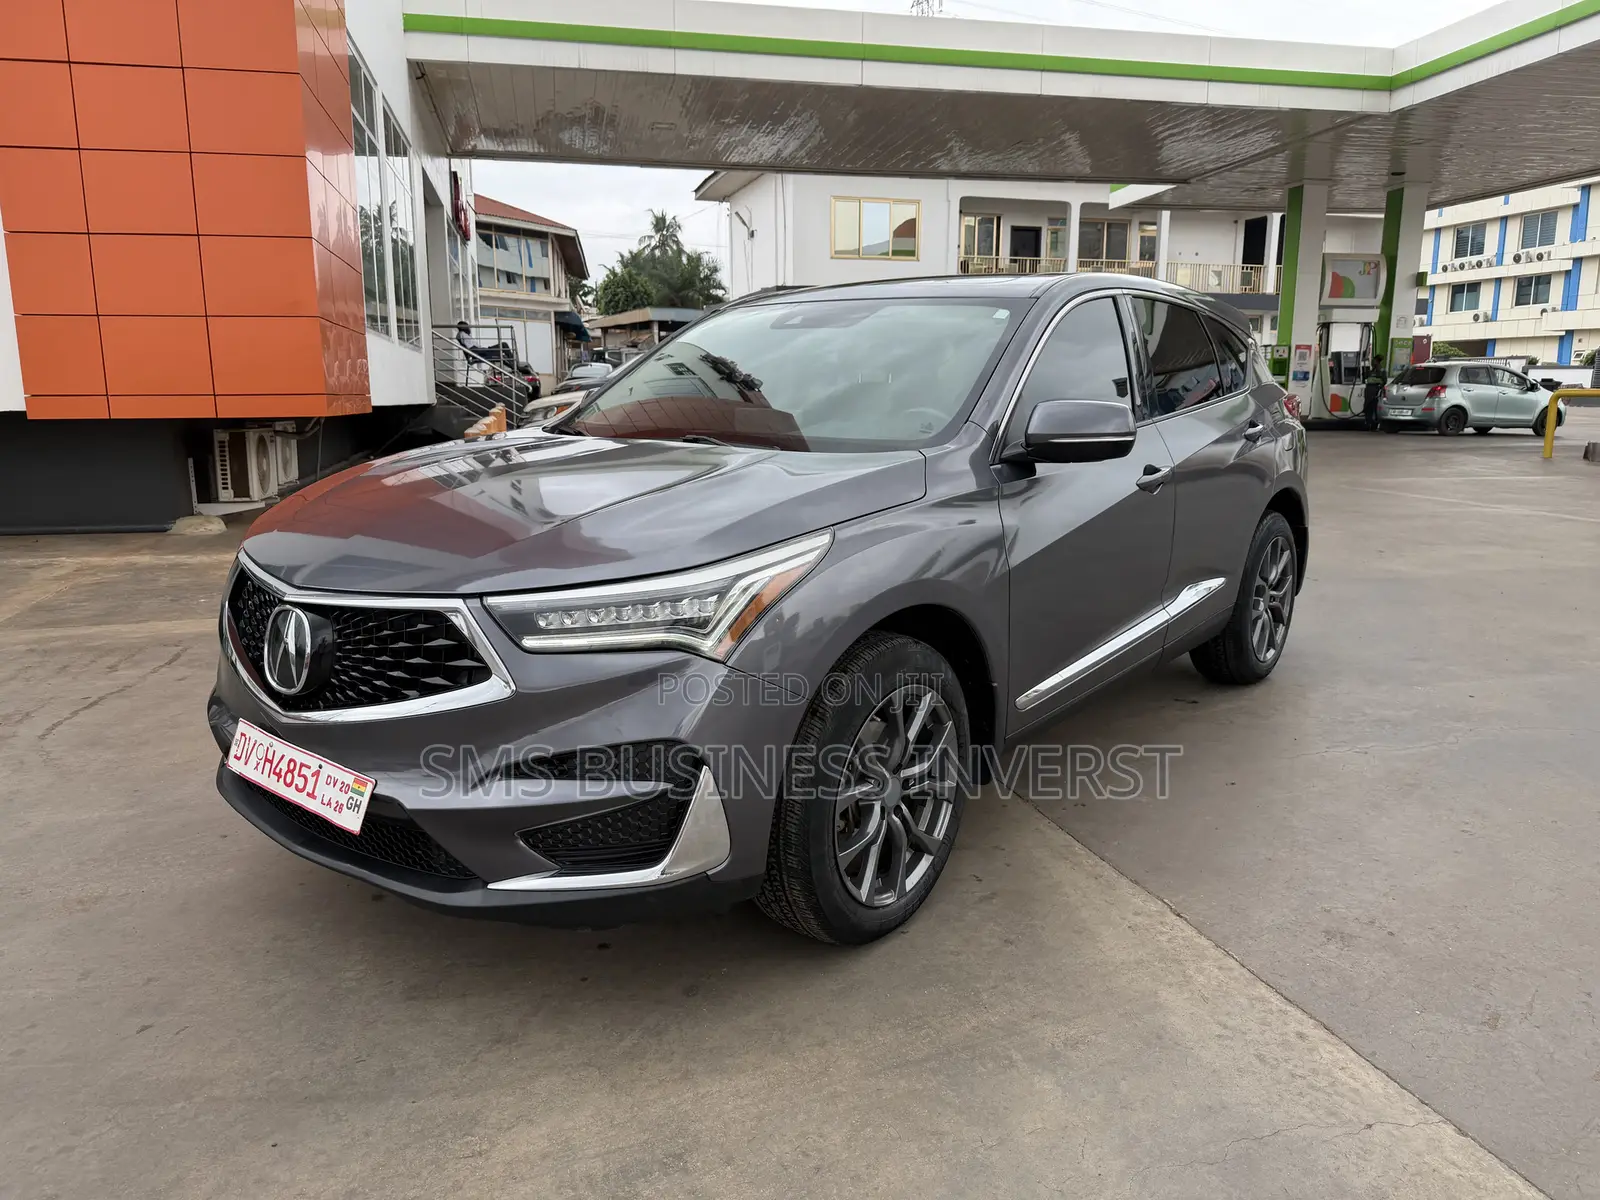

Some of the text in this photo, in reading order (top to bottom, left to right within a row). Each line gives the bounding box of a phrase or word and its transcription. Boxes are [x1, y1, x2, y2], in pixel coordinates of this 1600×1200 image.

[233, 732, 322, 801] DV H4851
[325, 773, 351, 795] DV 20
[320, 793, 332, 808] LA
[345, 795, 363, 815] GH
